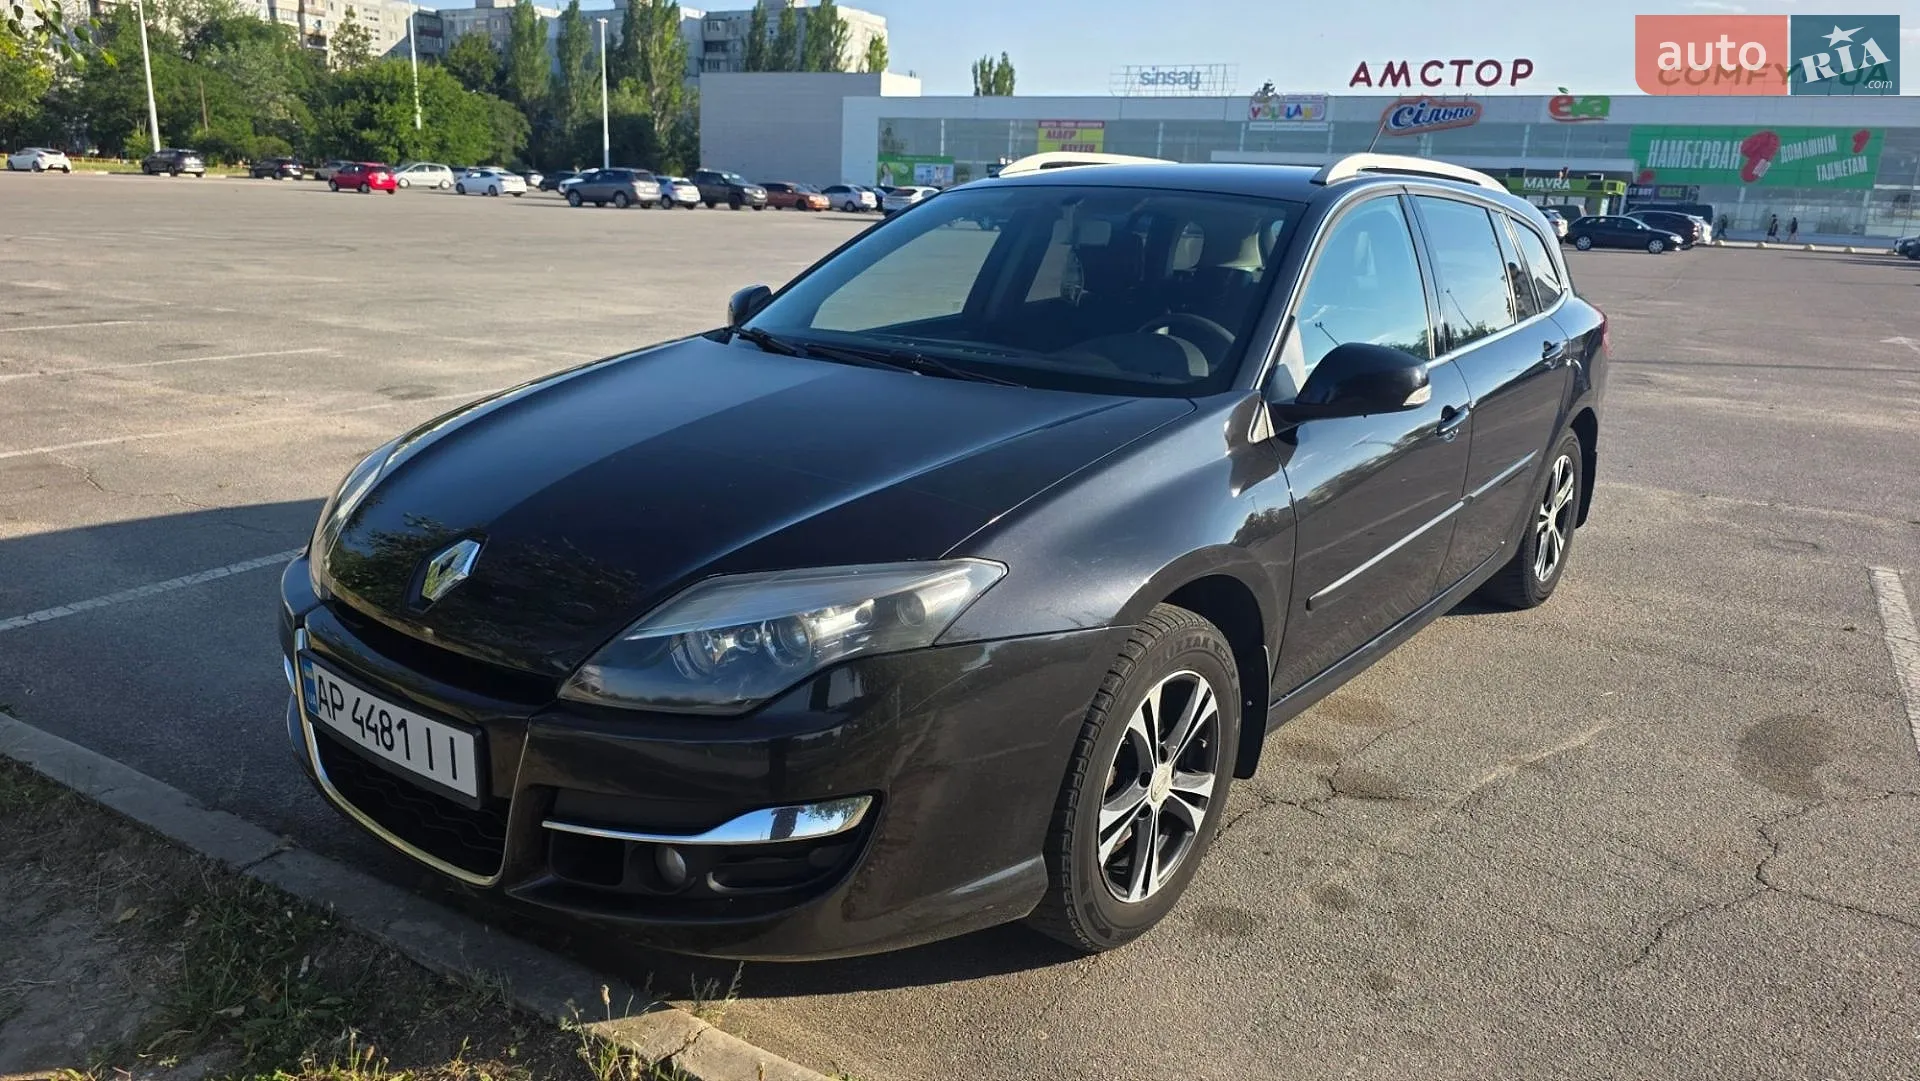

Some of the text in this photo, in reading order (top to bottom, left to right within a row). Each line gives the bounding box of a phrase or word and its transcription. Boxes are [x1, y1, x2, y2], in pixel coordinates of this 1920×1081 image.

[1139, 66, 1202, 91] sinsay
[1349, 59, 1534, 88] АМСТОР
[1389, 101, 1477, 128] Сільпо
[1646, 139, 1743, 170] НАМБЕРВАН
[1780, 134, 1838, 164] ДОМАШНІМ
[1816, 156, 1868, 182] ГАДЖЕТАМ
[1523, 178, 1571, 190] MAVRA
[316, 674, 345, 721] AP
[351, 697, 411, 761] 4481
